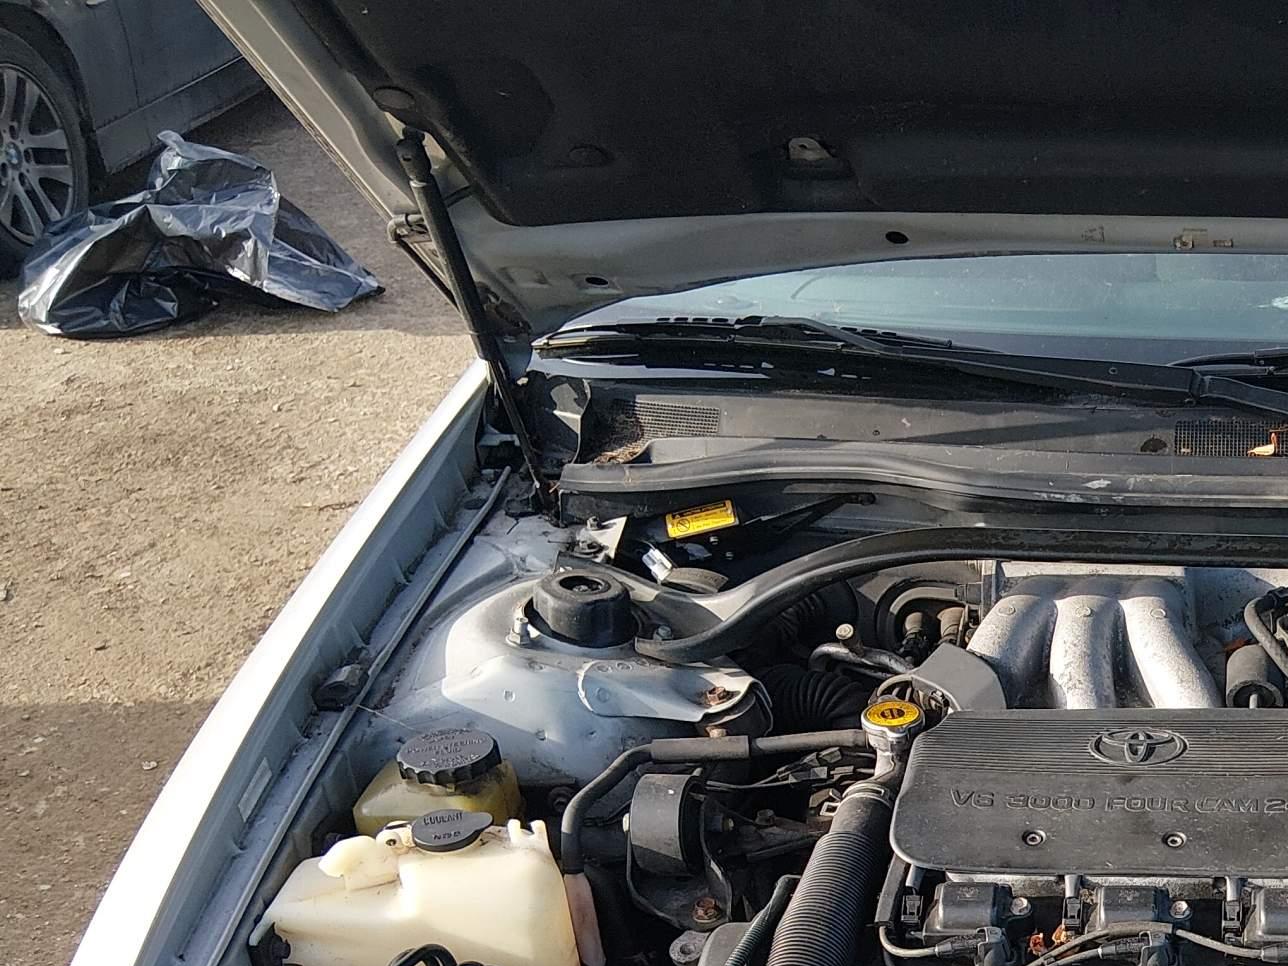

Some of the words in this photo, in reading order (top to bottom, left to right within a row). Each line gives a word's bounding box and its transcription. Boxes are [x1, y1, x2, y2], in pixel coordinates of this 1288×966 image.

[951, 788, 995, 809] V6
[1006, 793, 1095, 811] 3000
[1105, 796, 1189, 813] FOUR
[1194, 797, 1259, 813] CAM
